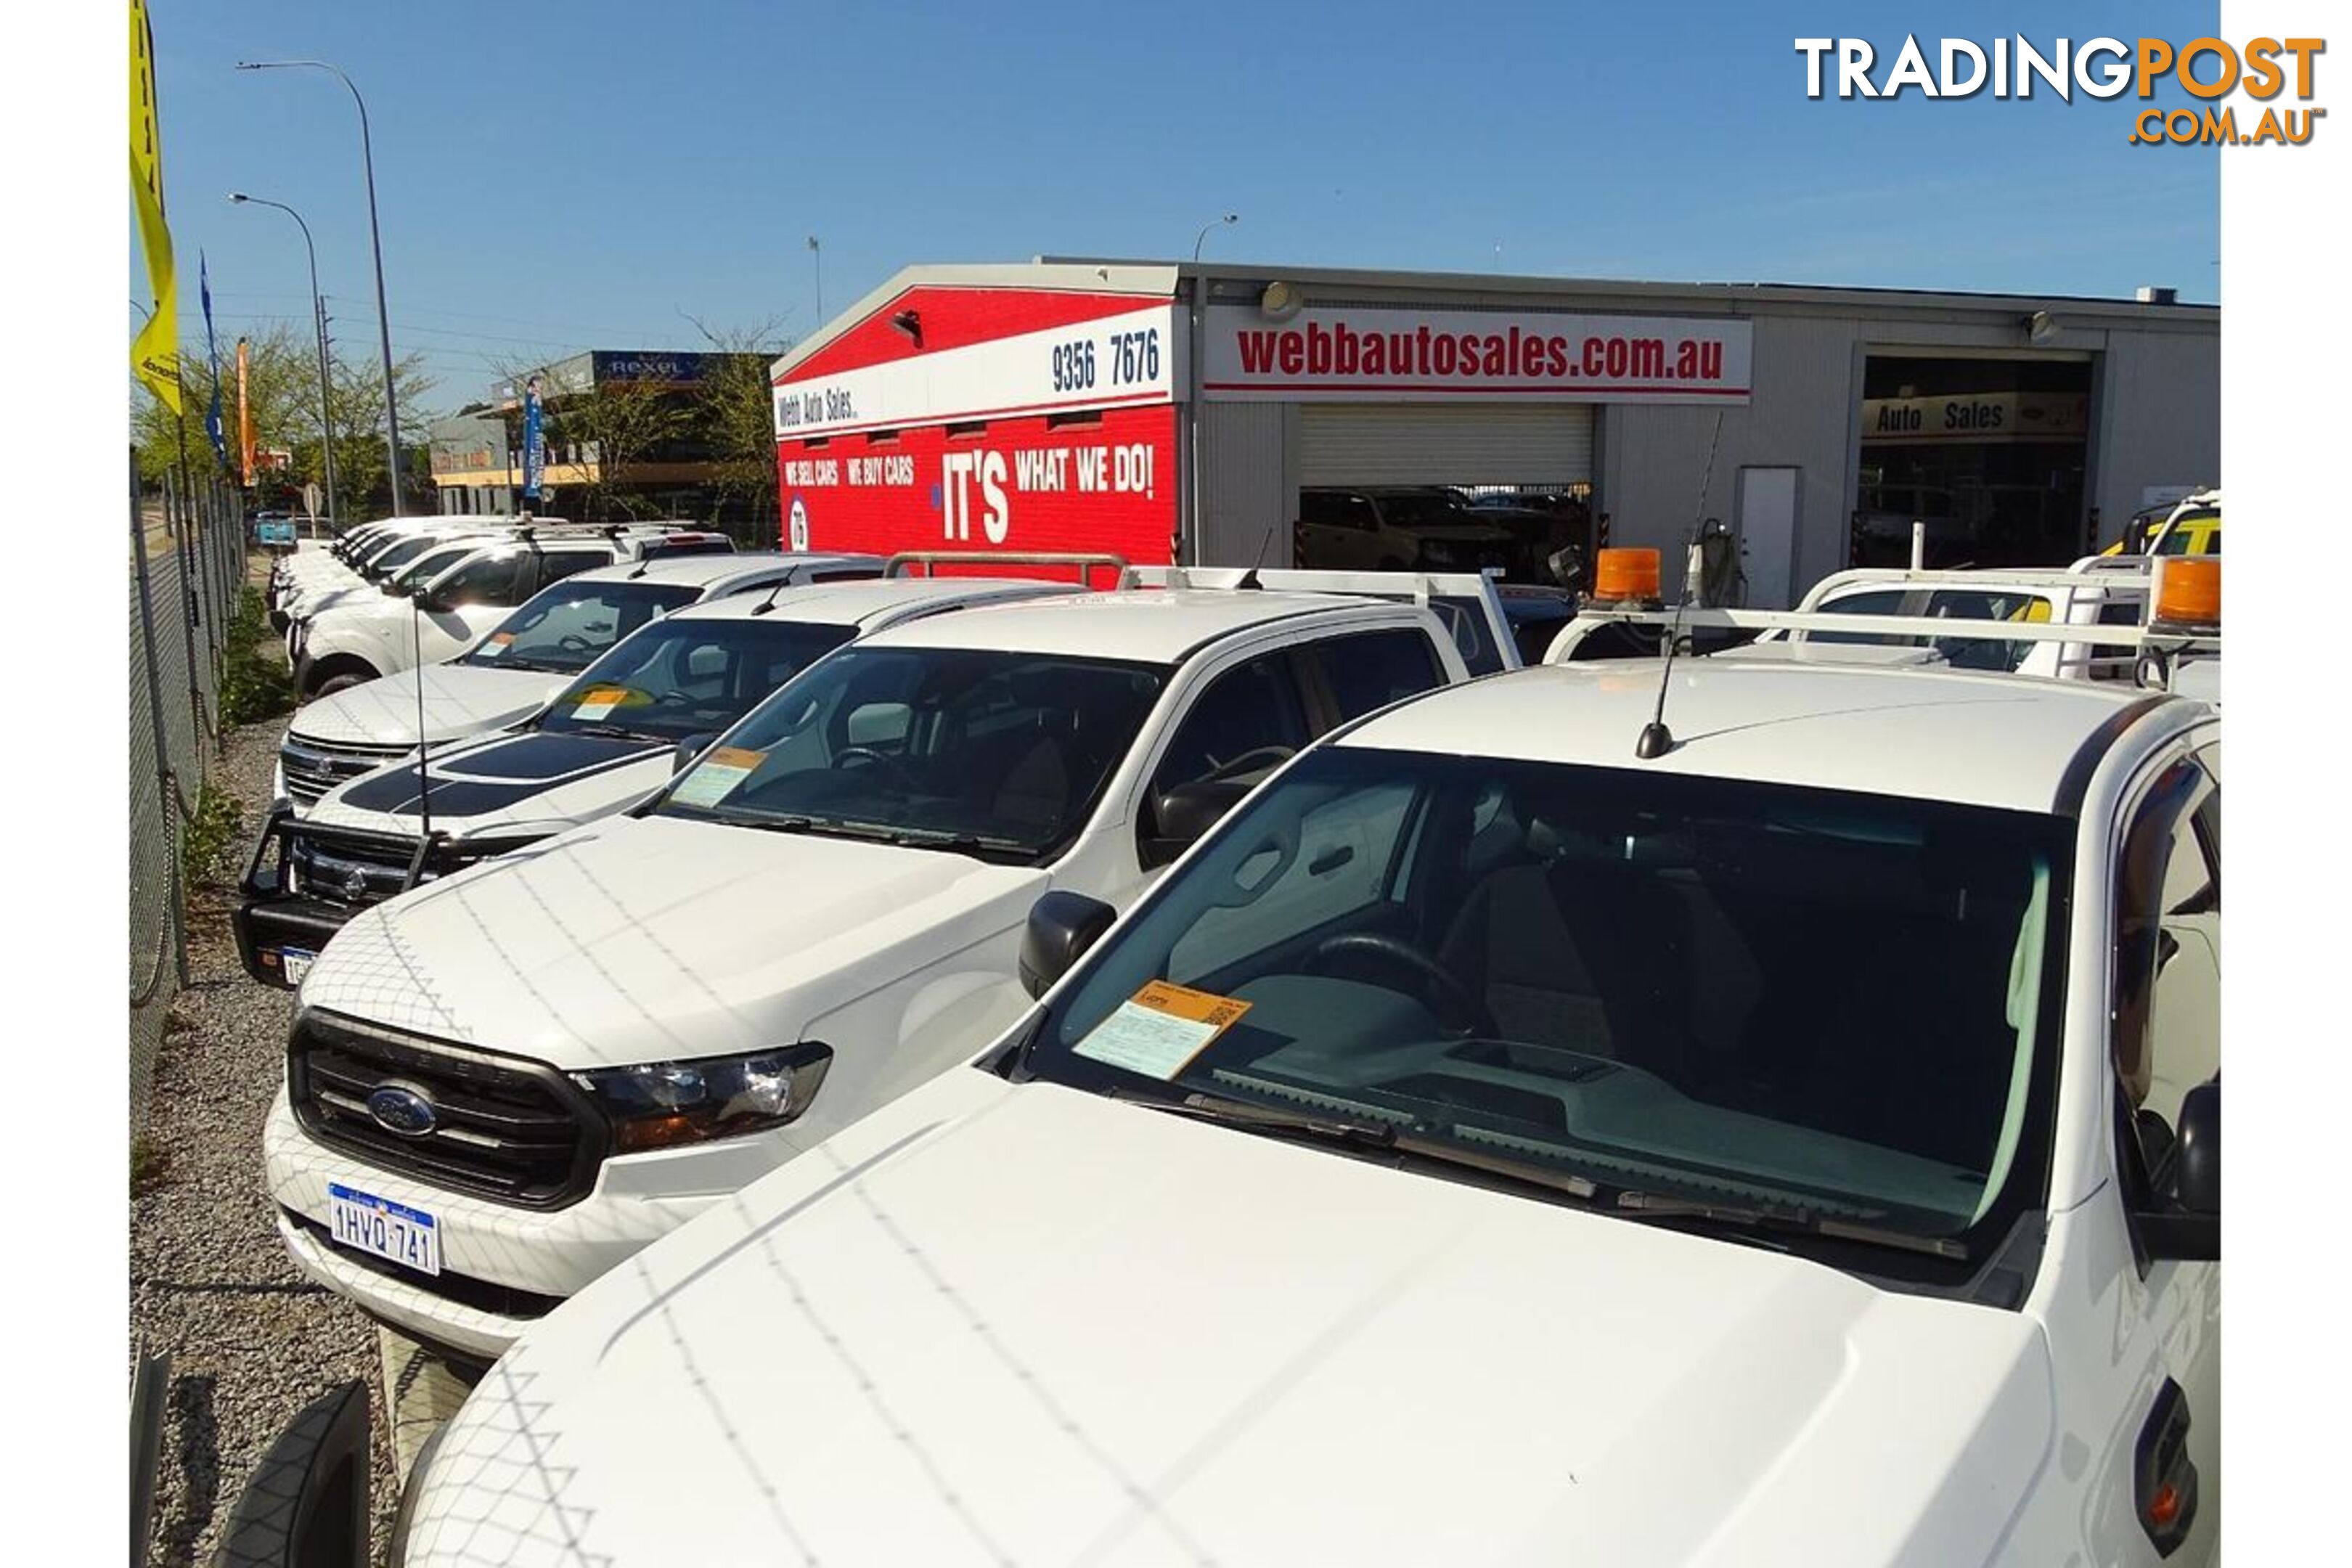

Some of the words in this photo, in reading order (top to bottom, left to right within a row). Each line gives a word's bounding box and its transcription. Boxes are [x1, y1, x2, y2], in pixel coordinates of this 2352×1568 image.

[1053, 340, 1095, 392] 9356
[1111, 327, 1159, 385] 7676
[1237, 322, 1723, 380] webbautosales.com.au
[778, 396, 801, 427] Webb
[804, 392, 822, 424] Auto
[826, 387, 852, 421] Sales
[1877, 405, 1922, 432] Auto
[1944, 401, 2003, 429] Sales
[785, 461, 798, 486] WE
[798, 460, 816, 486] SELL
[815, 459, 838, 486] CARS
[846, 457, 862, 486] WE
[864, 456, 883, 486] BUY
[885, 454, 914, 486] CARS
[942, 449, 1009, 544] IT'S
[1015, 448, 1069, 491] WHAT
[1076, 446, 1108, 491] WE
[1114, 443, 1154, 500] DO!
